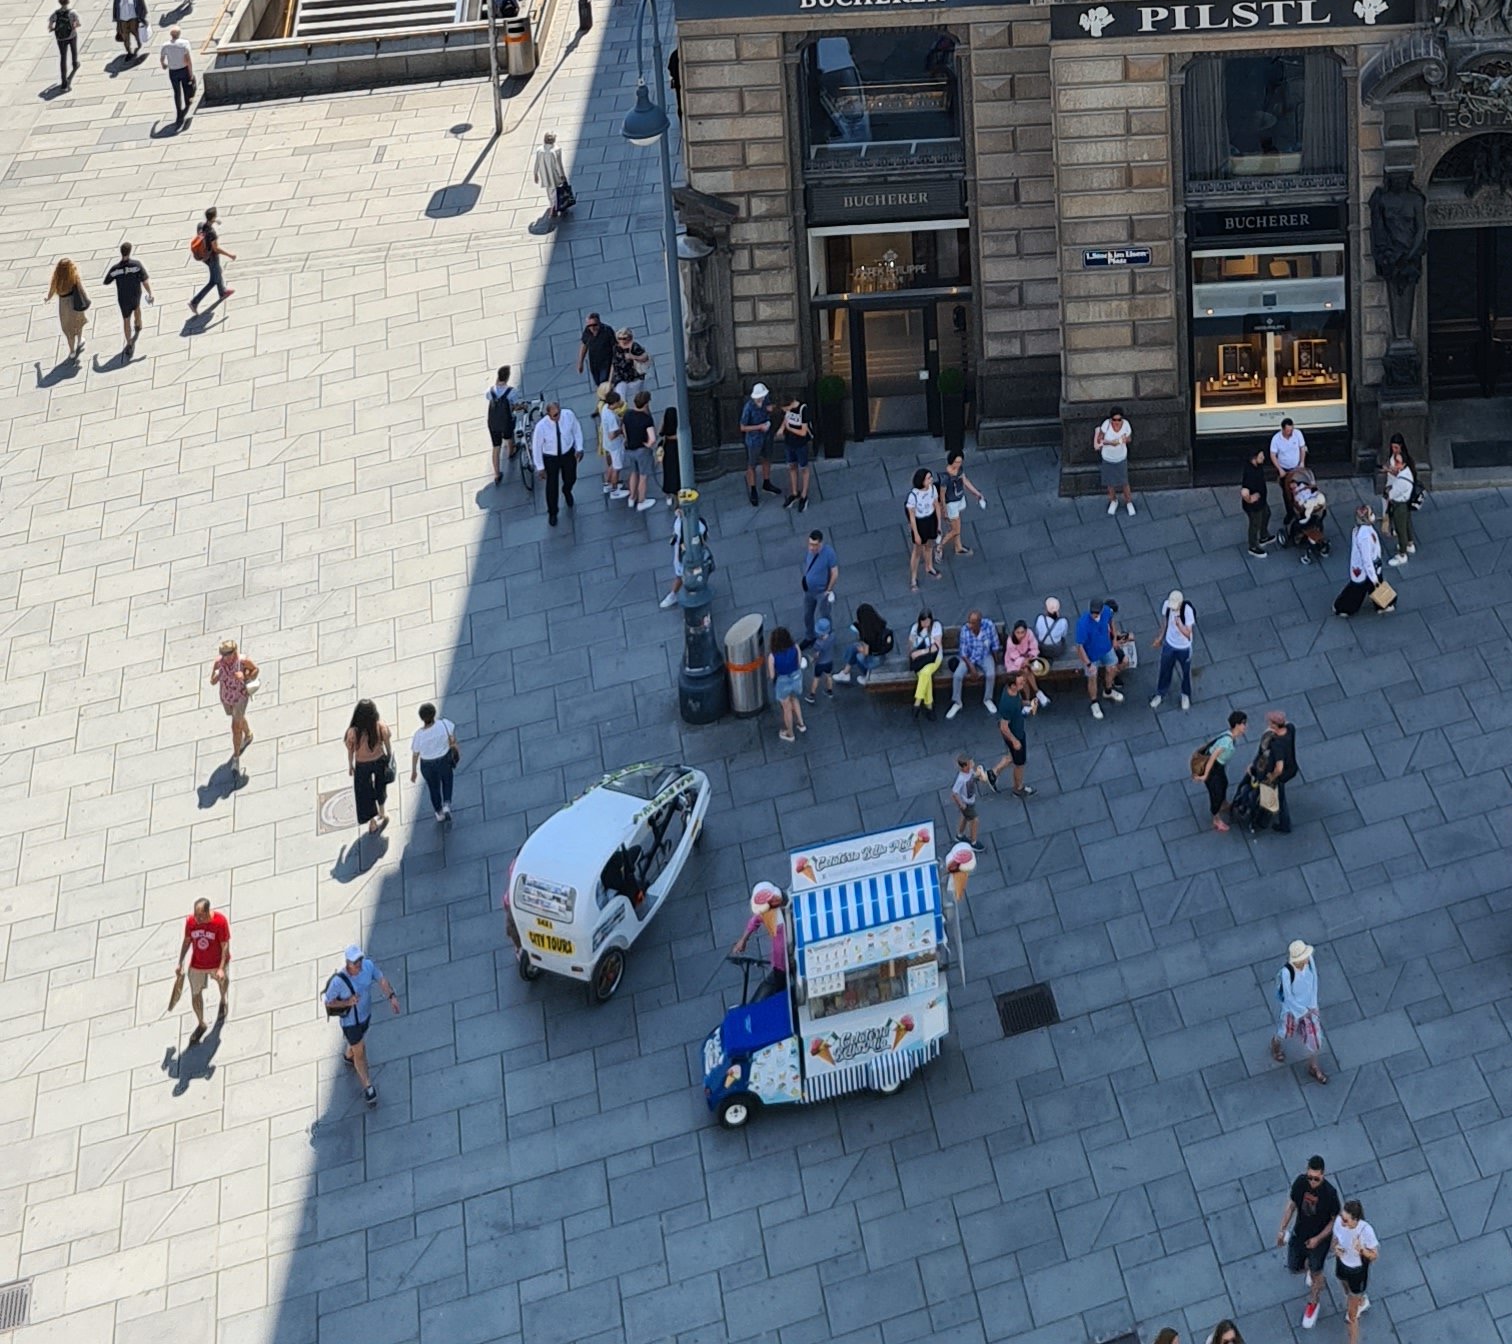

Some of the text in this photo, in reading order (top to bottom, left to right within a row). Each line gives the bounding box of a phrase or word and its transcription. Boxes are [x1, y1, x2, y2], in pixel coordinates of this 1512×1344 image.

[1137, 0, 1331, 32] PILSTL
[843, 192, 929, 207] BUCHERER
[1224, 213, 1310, 230] BUCHERER
[528, 931, 573, 954] CITY TOURS
